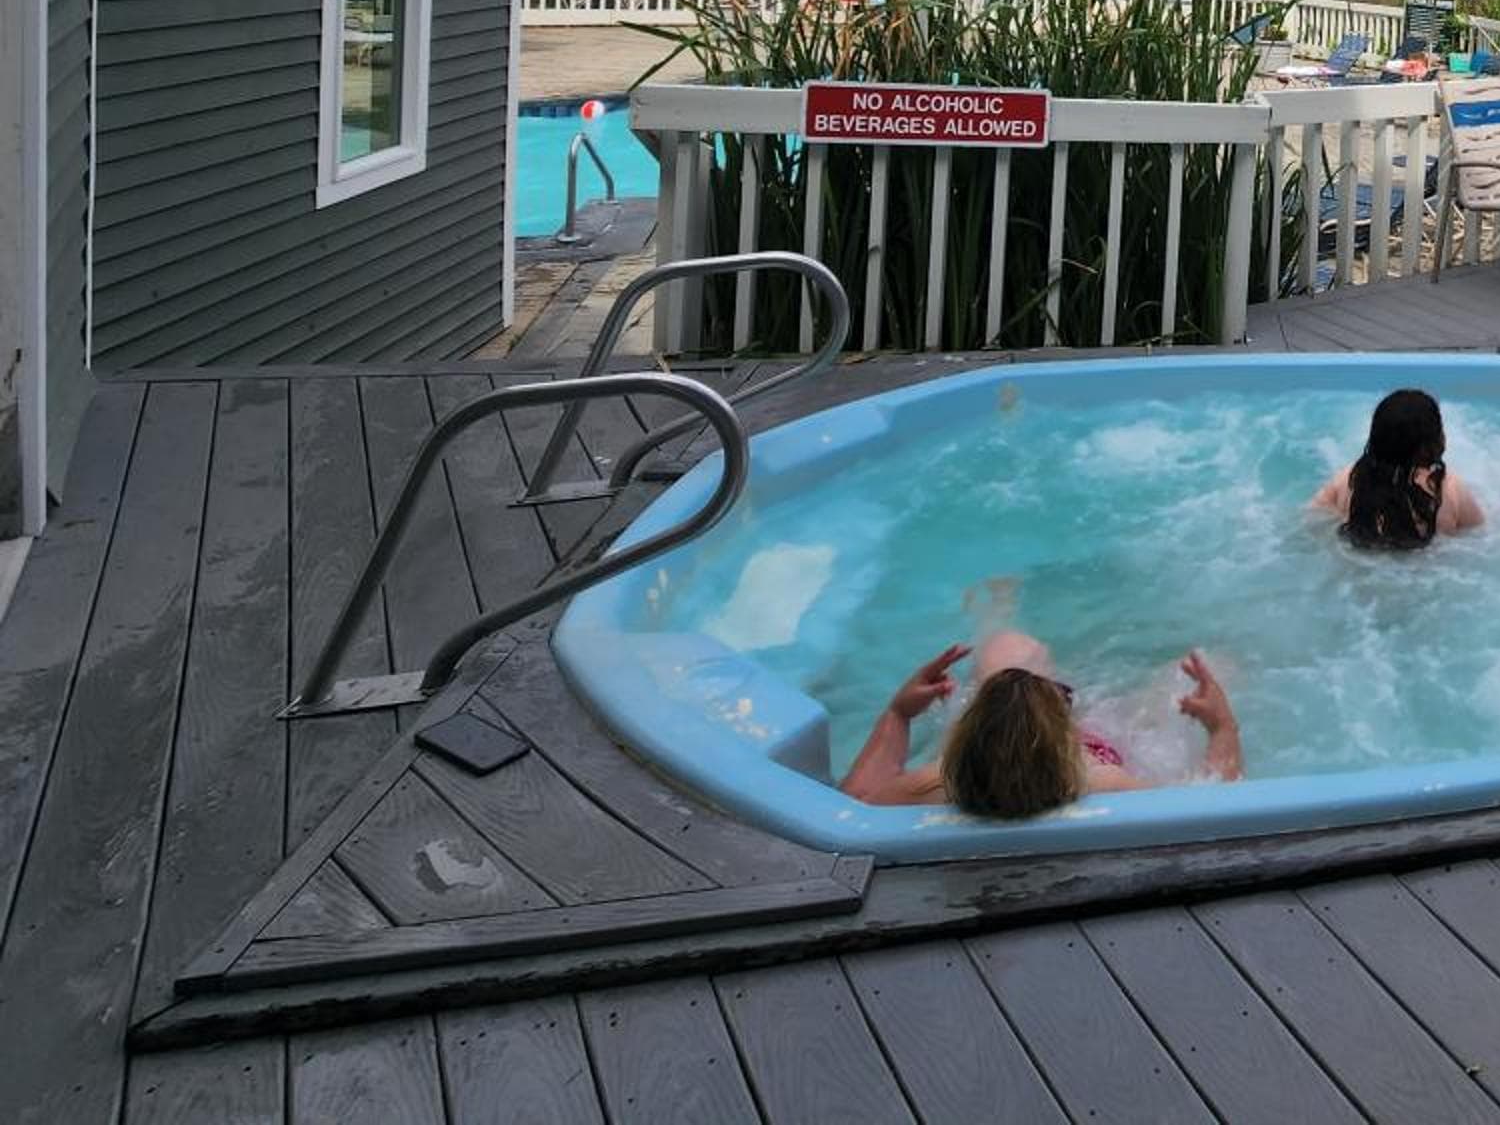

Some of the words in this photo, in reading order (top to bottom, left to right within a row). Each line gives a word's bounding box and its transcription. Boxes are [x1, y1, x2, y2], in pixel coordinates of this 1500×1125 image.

[852, 92, 883, 111] NO
[891, 94, 1004, 114] ALCOHOLIC
[814, 114, 935, 135] BEVERAGES
[943, 118, 1037, 137] ALLOWED
